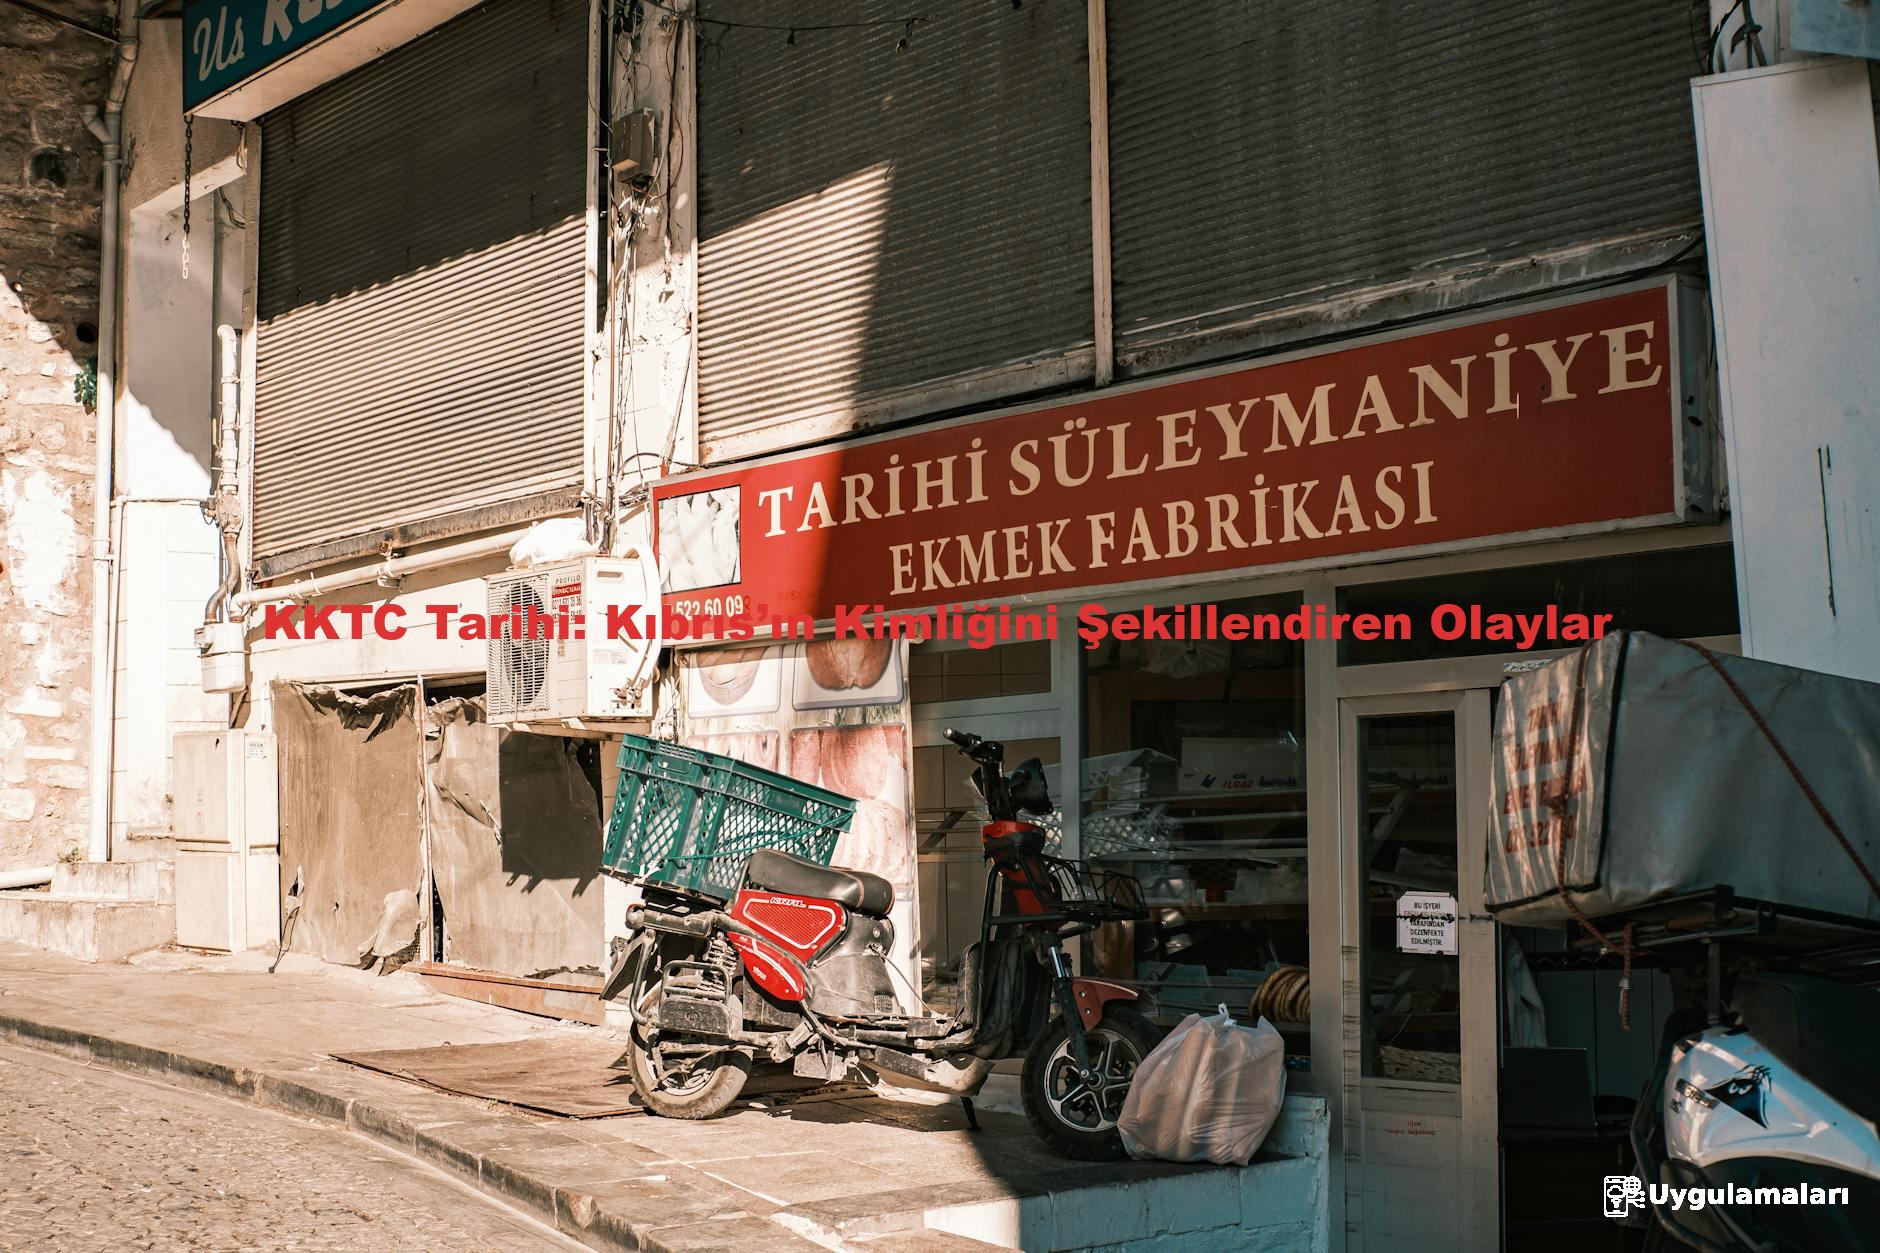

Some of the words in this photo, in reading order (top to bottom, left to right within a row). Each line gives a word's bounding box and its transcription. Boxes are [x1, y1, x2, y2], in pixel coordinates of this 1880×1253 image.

[757, 436, 989, 538] TARİHİ
[1008, 319, 1664, 497] SÜLEYMANİYE
[888, 517, 1077, 596] EKMEK
[1086, 460, 1439, 570] FABRİKASI
[1410, 928, 1445, 937] DEZENFEKTE
